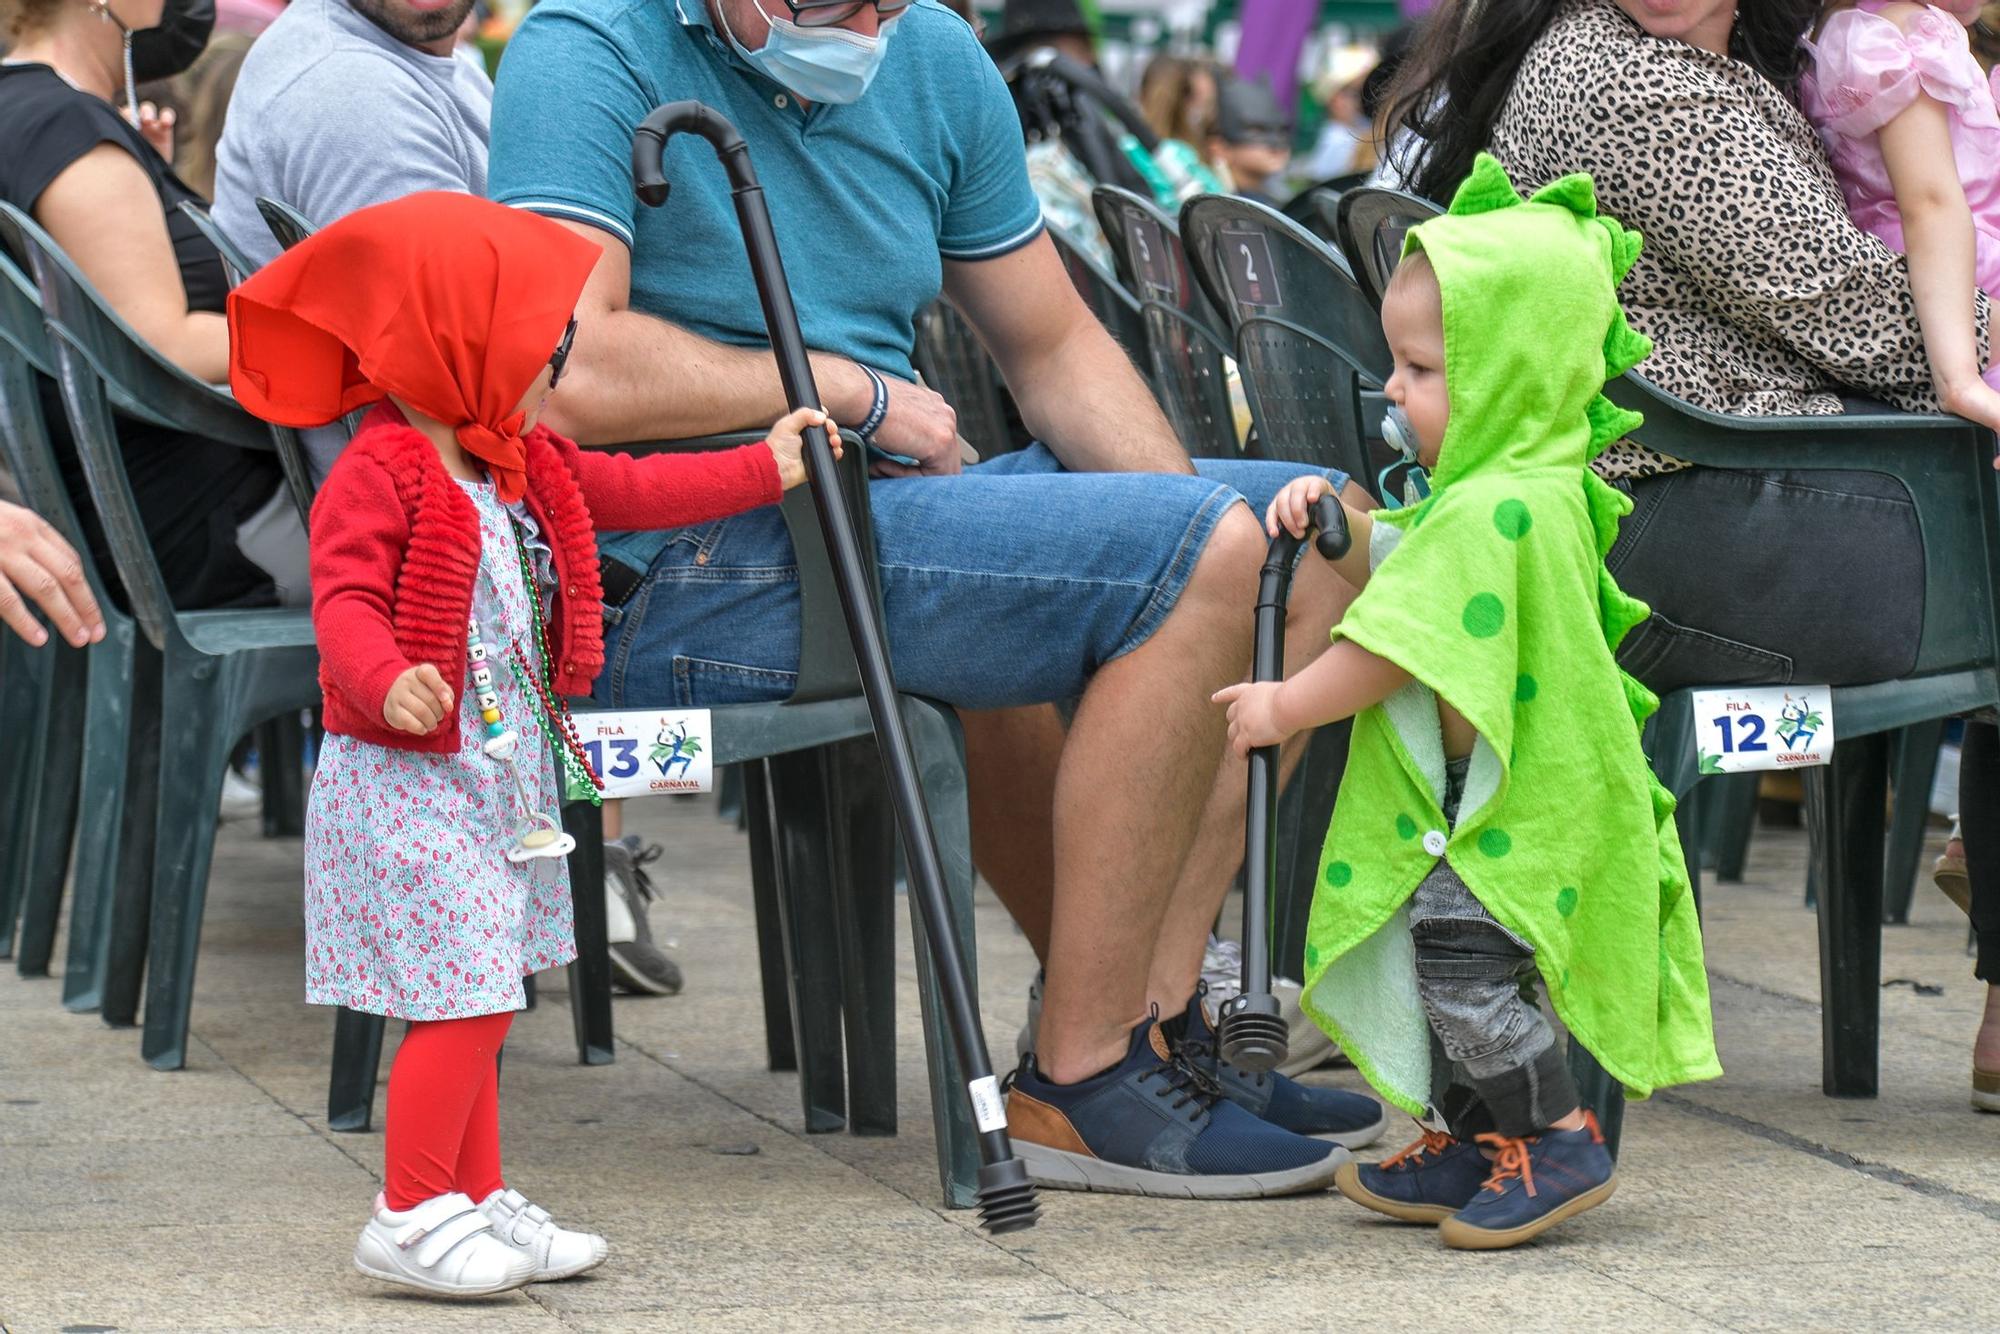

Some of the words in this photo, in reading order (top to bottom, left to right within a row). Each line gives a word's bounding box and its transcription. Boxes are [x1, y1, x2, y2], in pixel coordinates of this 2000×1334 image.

[1239, 243, 1258, 281] 2
[1726, 702, 1752, 711] FILA
[597, 726, 625, 736] FILA
[1712, 714, 1768, 753] 12
[584, 739, 640, 778] 13
[1776, 752, 1820, 763] CARNAVAL
[649, 779, 700, 790] CARNAVAL
